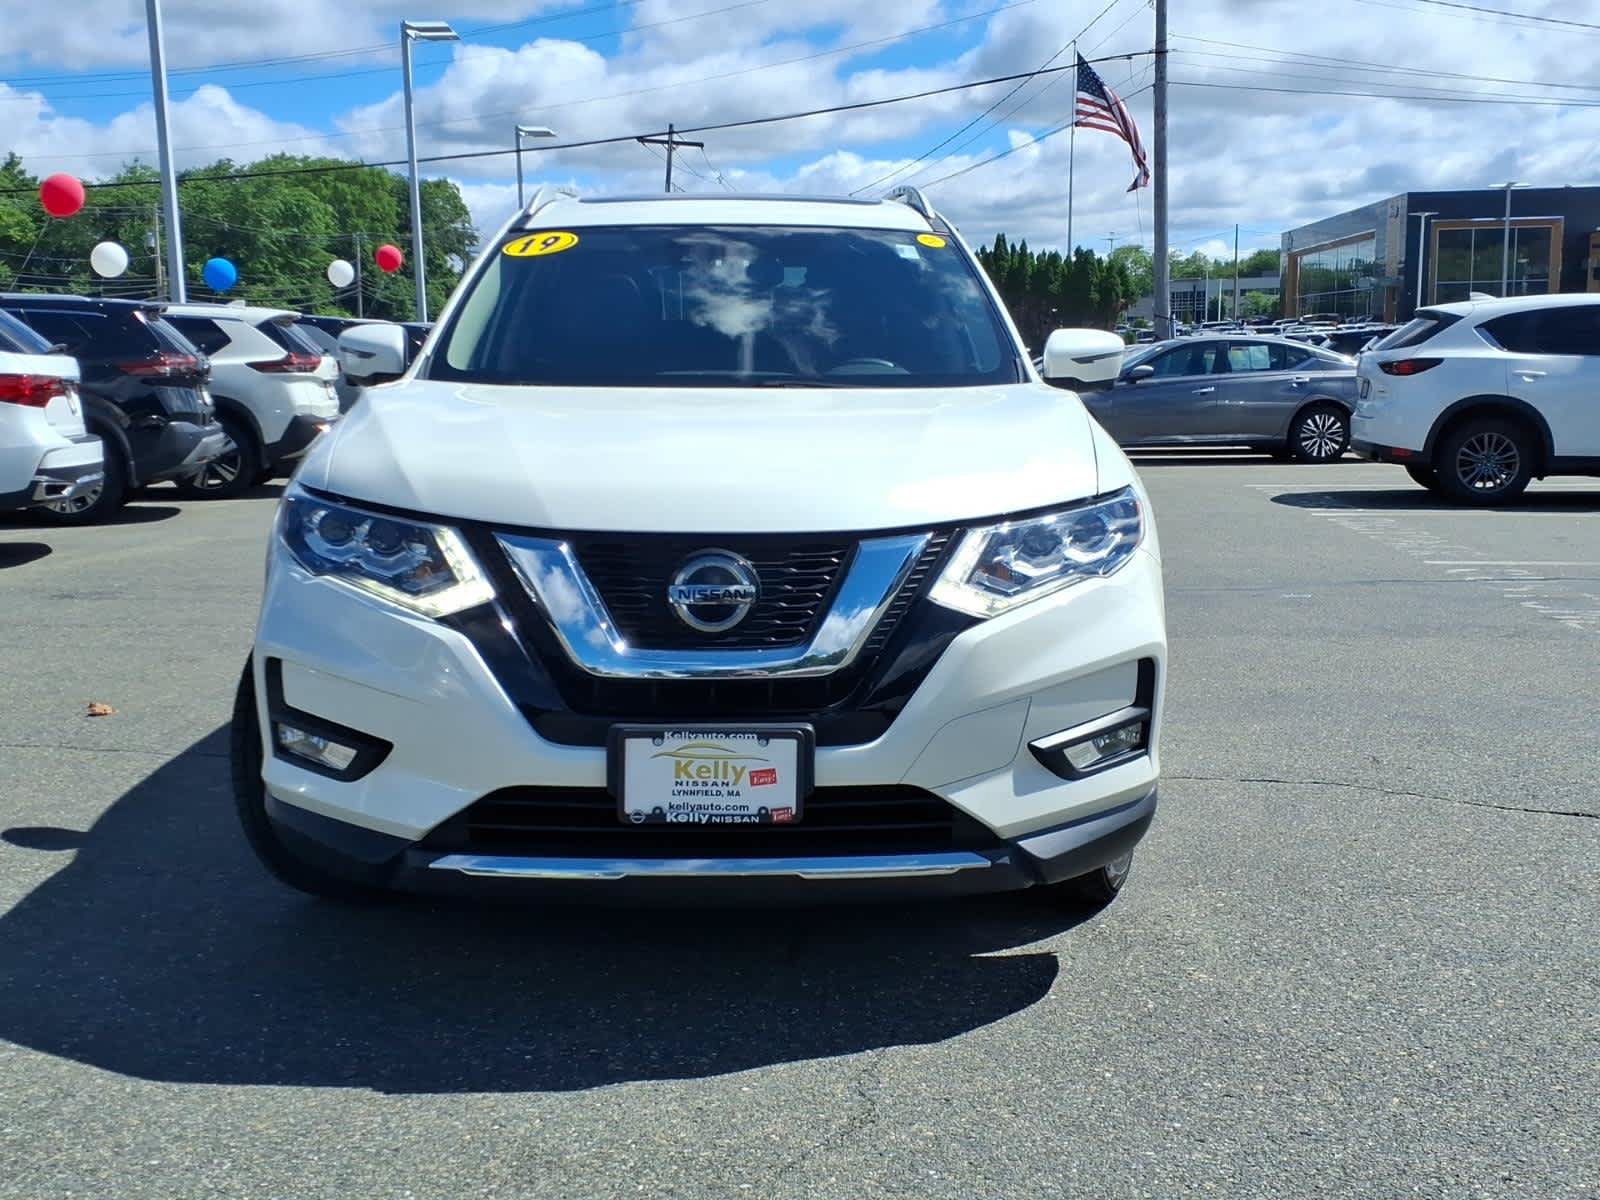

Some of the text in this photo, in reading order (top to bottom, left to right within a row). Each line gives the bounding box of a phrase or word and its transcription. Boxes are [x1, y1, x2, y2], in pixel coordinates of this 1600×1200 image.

[519, 236, 561, 253] 19
[678, 589, 747, 600] NISSAN
[674, 760, 746, 785] Kelly
[672, 789, 725, 797] LYNNFIELD,
[668, 802, 749, 812] kellyauto.com
[666, 812, 760, 824] Kelly NISSAN
